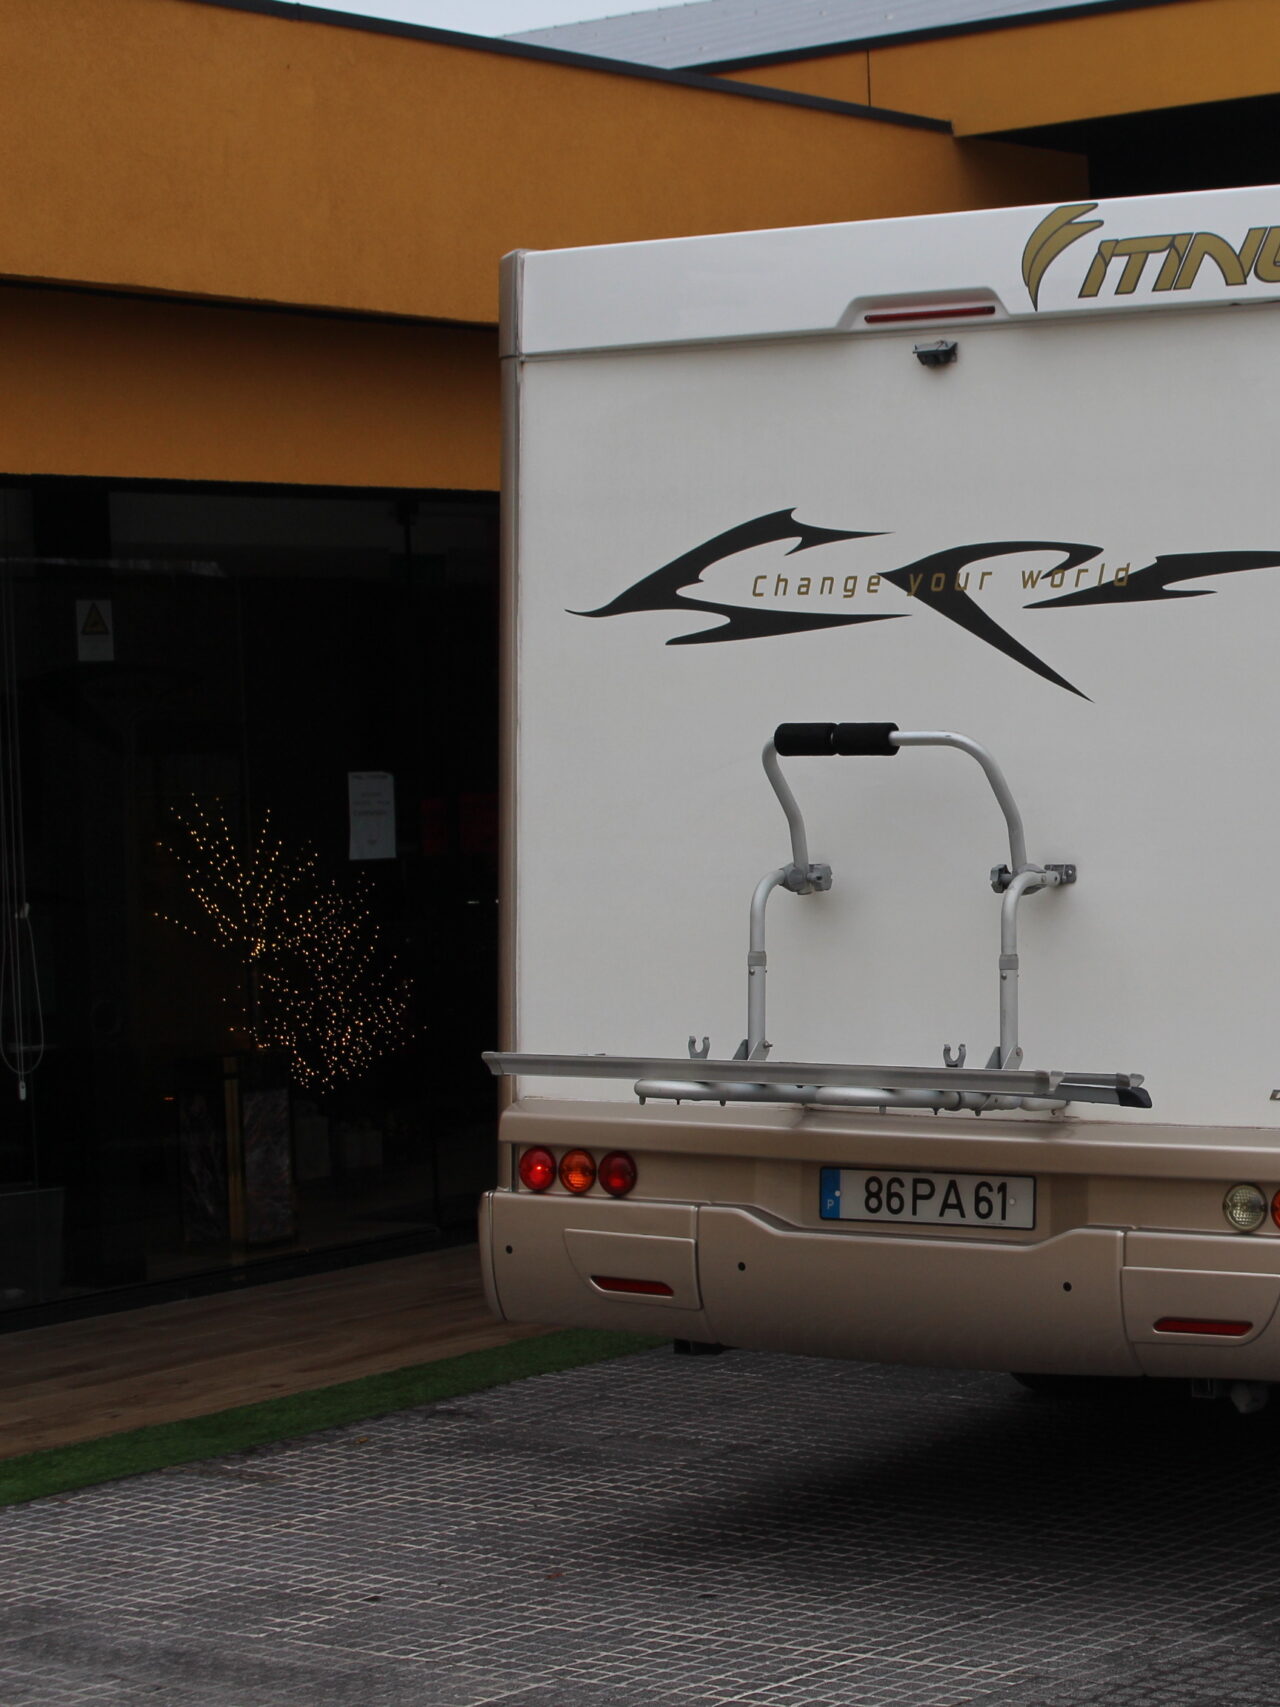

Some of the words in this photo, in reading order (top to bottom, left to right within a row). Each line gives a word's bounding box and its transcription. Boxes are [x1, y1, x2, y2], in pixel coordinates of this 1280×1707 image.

[751, 572, 882, 599] Change
[906, 569, 994, 597] your
[1021, 562, 1132, 590] world
